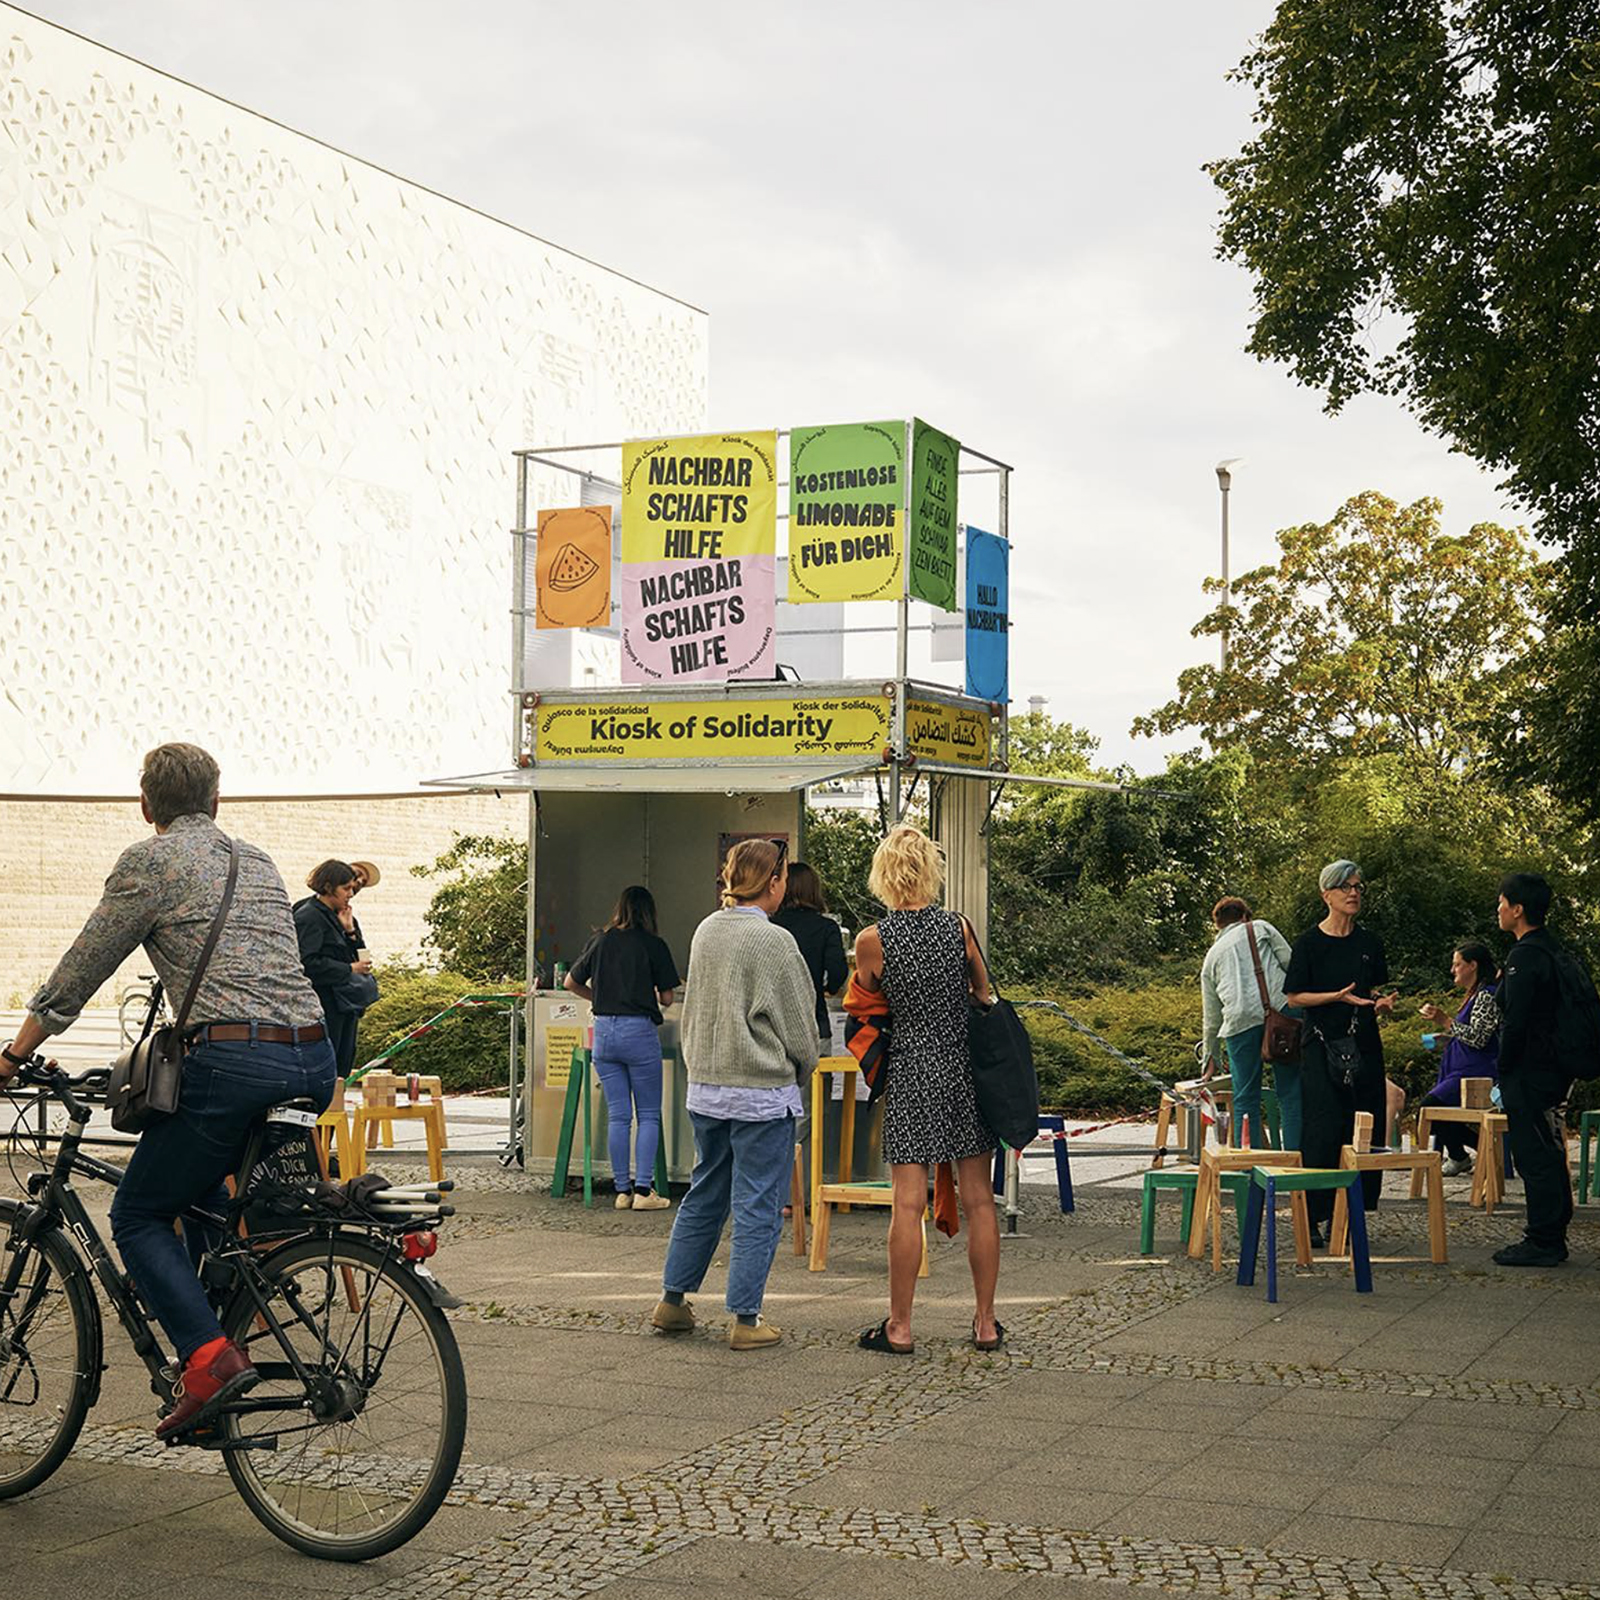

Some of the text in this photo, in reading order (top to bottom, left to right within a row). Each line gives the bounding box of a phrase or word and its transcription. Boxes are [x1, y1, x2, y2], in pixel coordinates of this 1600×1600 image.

[648, 456, 753, 487] NACHBAR
[795, 465, 897, 495] KOSTENLOSE
[647, 492, 748, 523] SCHAFTS
[797, 502, 896, 528] LIMONADE
[664, 529, 724, 560] HILFE
[801, 532, 895, 568] FÜR DICH!
[640, 559, 742, 608] NACHBAR
[977, 584, 998, 607] HALLO
[644, 595, 745, 642] SCHAFTS
[670, 635, 728, 675] HILFE
[541, 705, 649, 733] Quiosco de la solidaridad
[591, 712, 833, 741] Kiosk of Solidarity
[793, 700, 886, 725] Kiosk der Solidarität
[543, 740, 624, 756] Dayanışma büfesi
[280, 1159, 307, 1174] DICH
